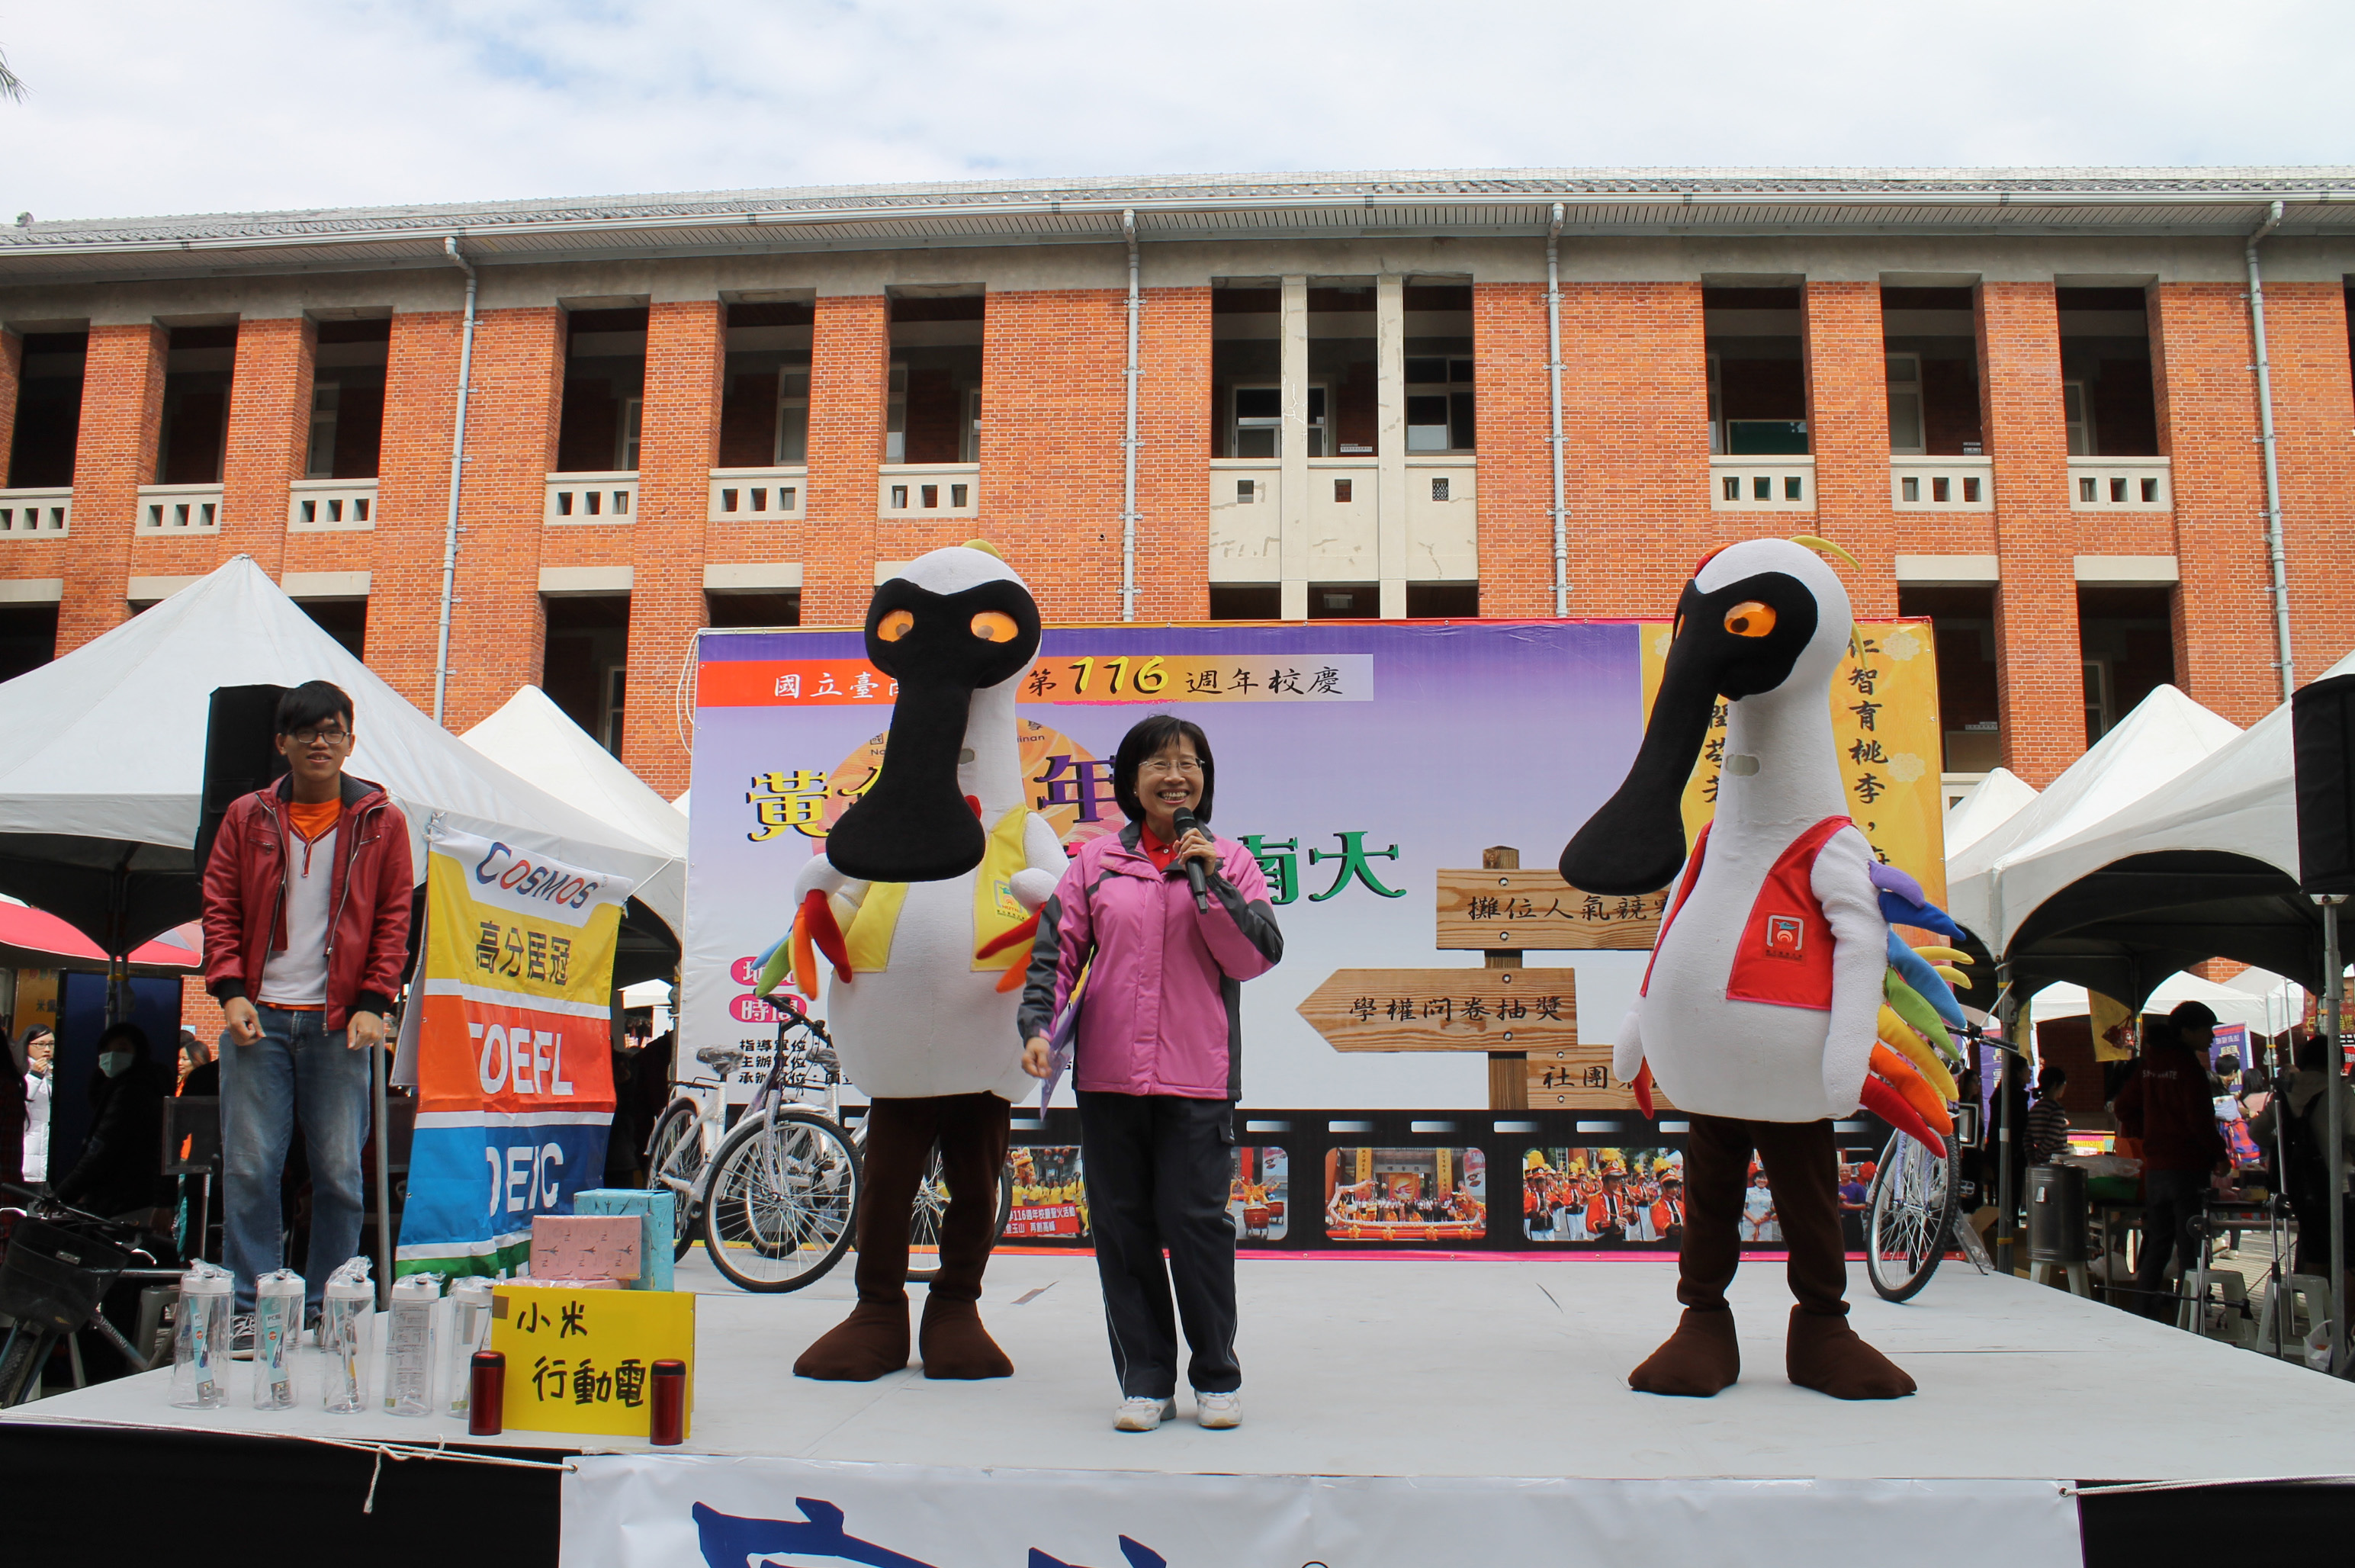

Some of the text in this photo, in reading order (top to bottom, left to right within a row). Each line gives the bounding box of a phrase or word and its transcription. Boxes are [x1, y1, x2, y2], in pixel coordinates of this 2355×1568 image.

[1028, 654, 1344, 696] 第116週年校慶
[1033, 753, 1116, 824] 年
[475, 920, 571, 987] 高分居冠
[1349, 994, 1564, 1022] 學權問卷抽獎
[516, 1300, 589, 1339] 小米
[530, 1355, 647, 1409] 行動電
